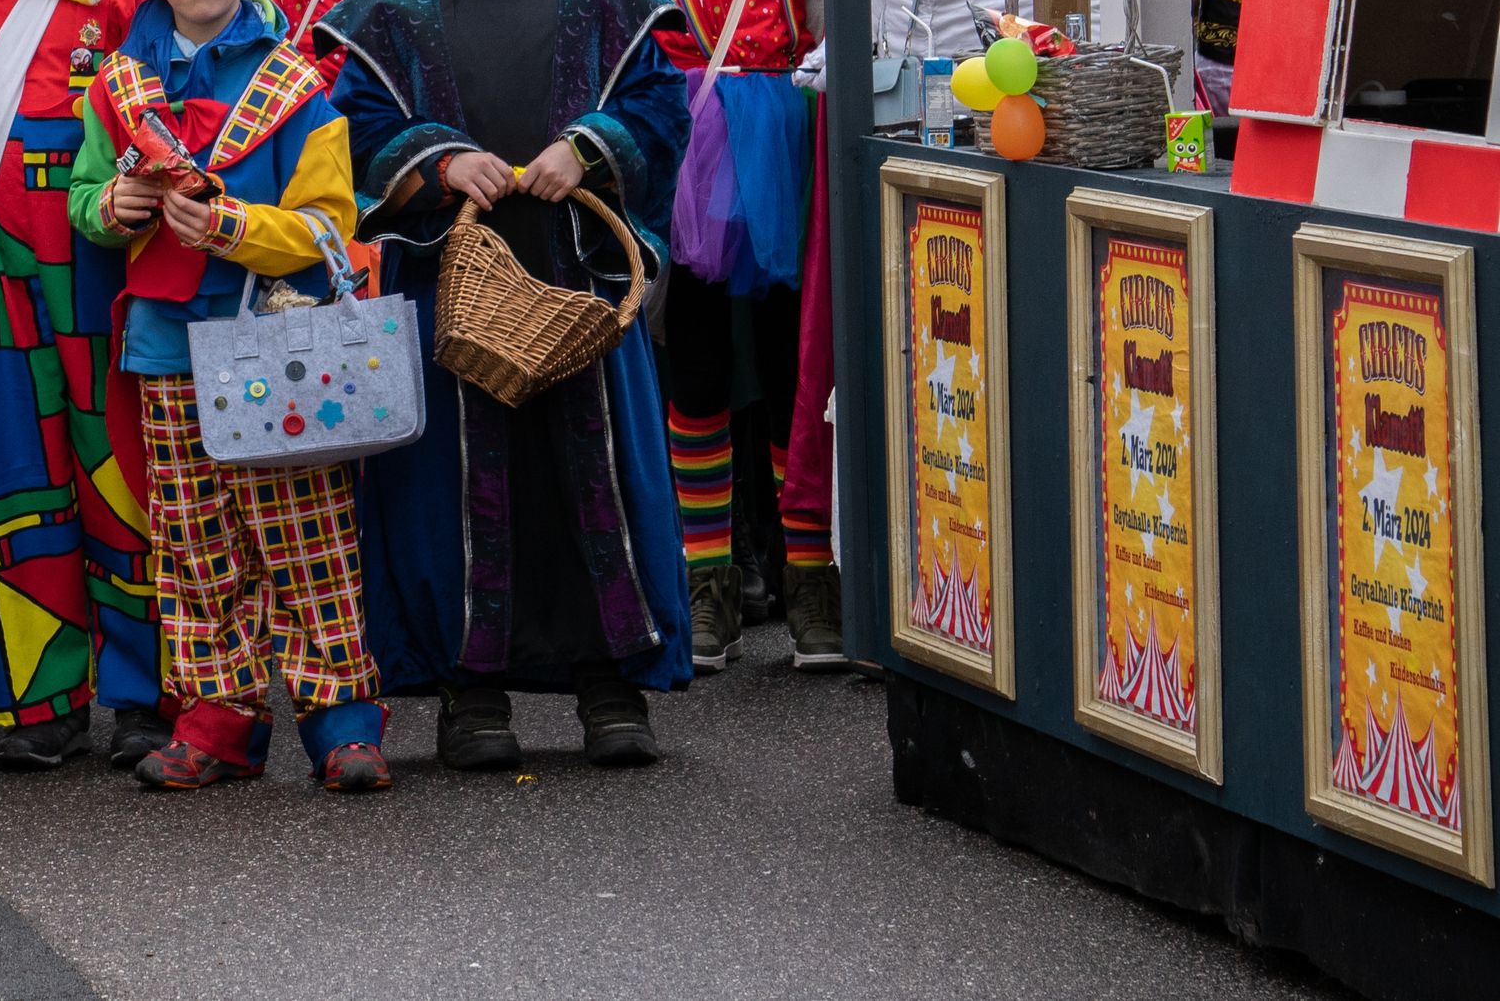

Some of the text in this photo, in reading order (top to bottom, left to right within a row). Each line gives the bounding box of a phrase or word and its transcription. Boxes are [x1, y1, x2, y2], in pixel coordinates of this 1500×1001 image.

[926, 234, 973, 296] CIRCUS
[1120, 273, 1175, 341] CIRCUS
[1358, 320, 1427, 396] CIRCUS
[928, 380, 976, 422] 2. März 2024
[955, 454, 986, 482] Körperich
[1121, 432, 1178, 480] 2. März 2024
[1113, 504, 1189, 545] Gaytalhalle Körperich
[1362, 495, 1431, 549] 2. März 2024
[1131, 551, 1142, 567] und
[1350, 573, 1445, 623] Gaytalhalle Körperich
[1353, 618, 1374, 641] Kaffee
[1375, 626, 1387, 645] und
